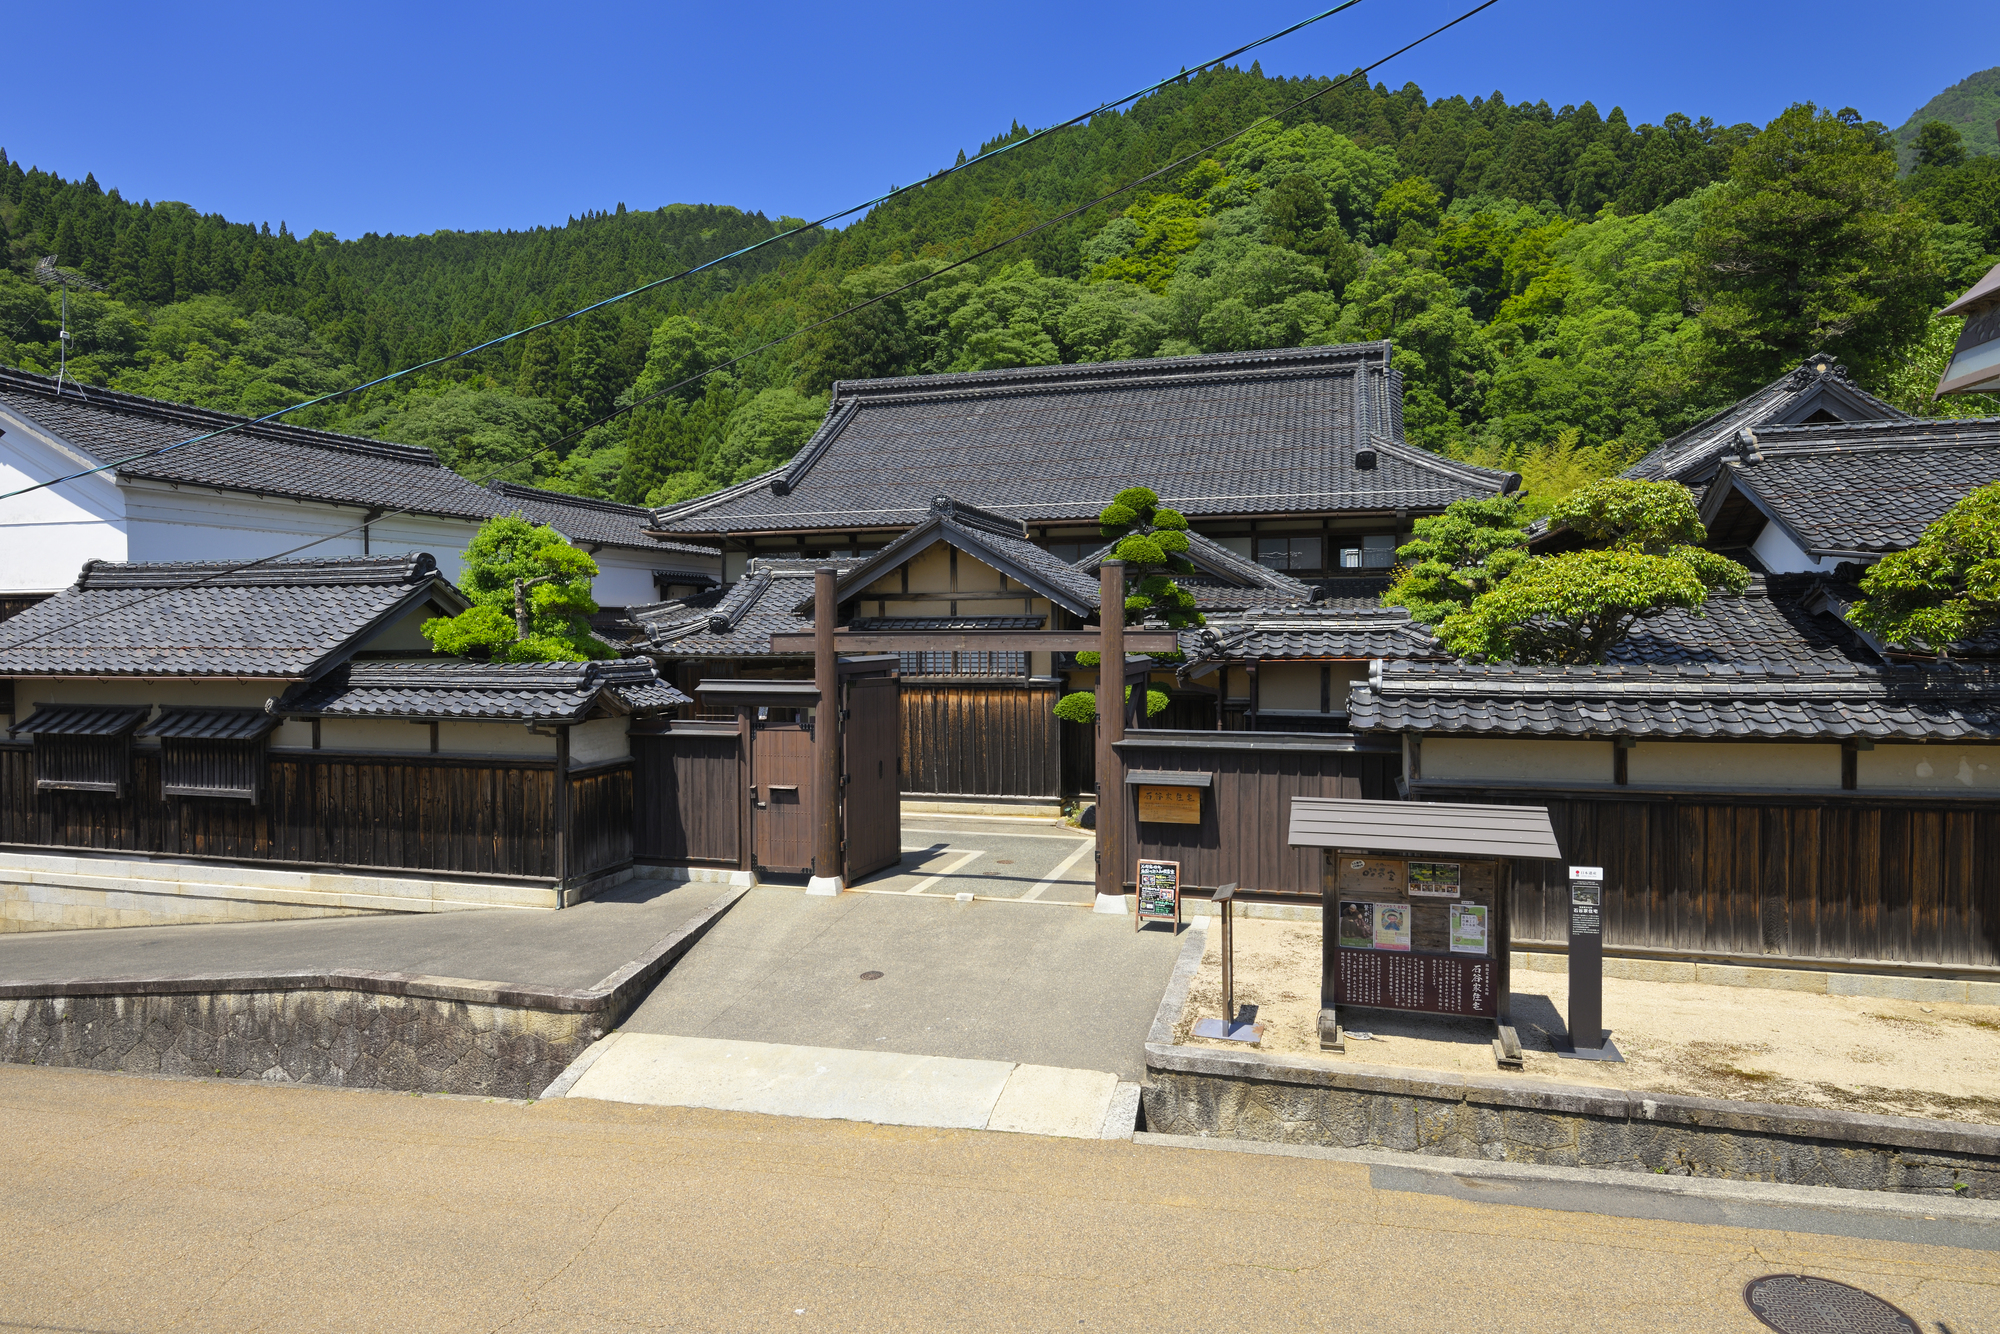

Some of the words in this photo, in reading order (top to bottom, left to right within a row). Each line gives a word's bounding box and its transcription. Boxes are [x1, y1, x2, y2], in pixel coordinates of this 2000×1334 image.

[1144, 791, 1195, 802] 石谷家住宅
[1471, 964, 1483, 1011] 石谷家住宅
